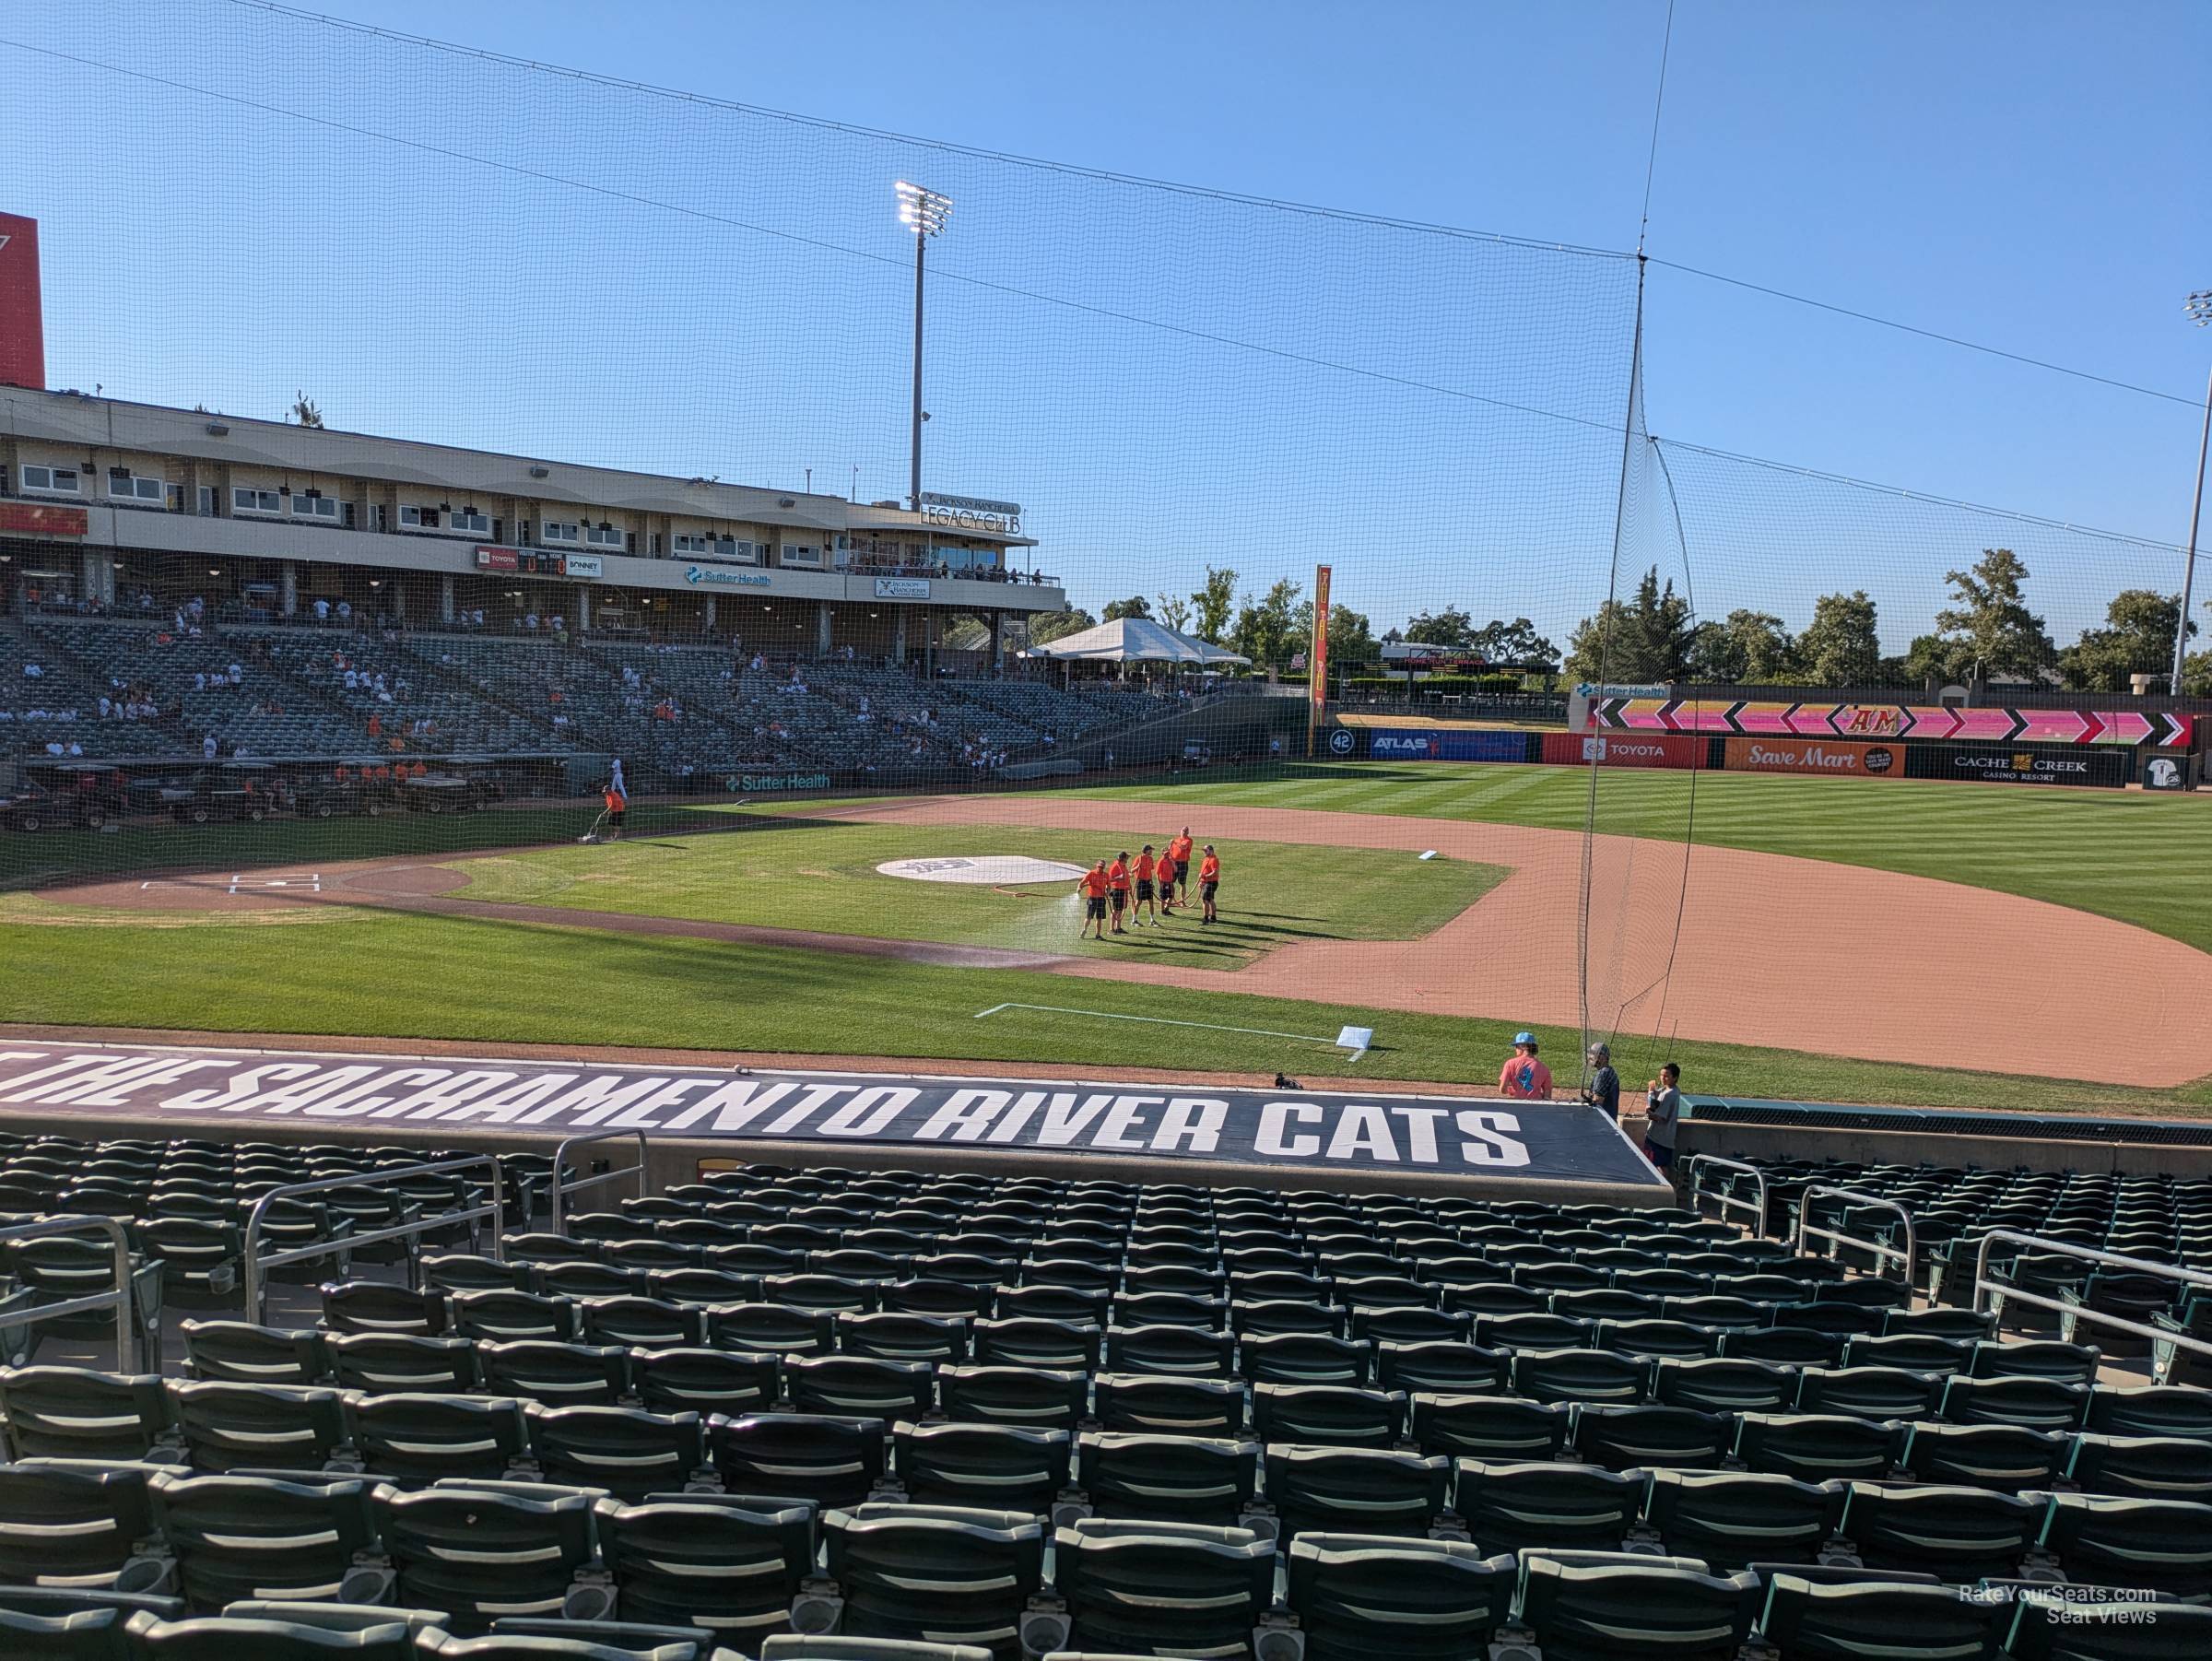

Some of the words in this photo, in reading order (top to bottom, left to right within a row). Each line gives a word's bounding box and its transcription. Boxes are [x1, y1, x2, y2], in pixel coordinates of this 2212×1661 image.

[921, 505, 981, 529] LEGACY
[982, 513, 1020, 535] CLUB
[491, 555, 515, 563] TOYOTA
[705, 571, 736, 583] Sutter
[739, 573, 771, 586] Health
[1630, 687, 1665, 697] Health
[1334, 736, 1349, 748] 42
[1374, 737, 1429, 750] ATLAS
[1611, 745, 1665, 756] TOYOTA
[1749, 745, 1796, 765] Save
[1798, 747, 1856, 768] Mart
[1955, 757, 2009, 769] CACHE
[2034, 760, 2087, 772] CREEK
[742, 775, 785, 791] Sutter
[788, 773, 830, 789] Health
[2021, 773, 2055, 782] RESORT
[0, 1054, 242, 1106] THE
[159, 1063, 923, 1136] SACRAMENTO
[912, 1089, 1230, 1152] RIVER
[1253, 1102, 1531, 1167] CATS
